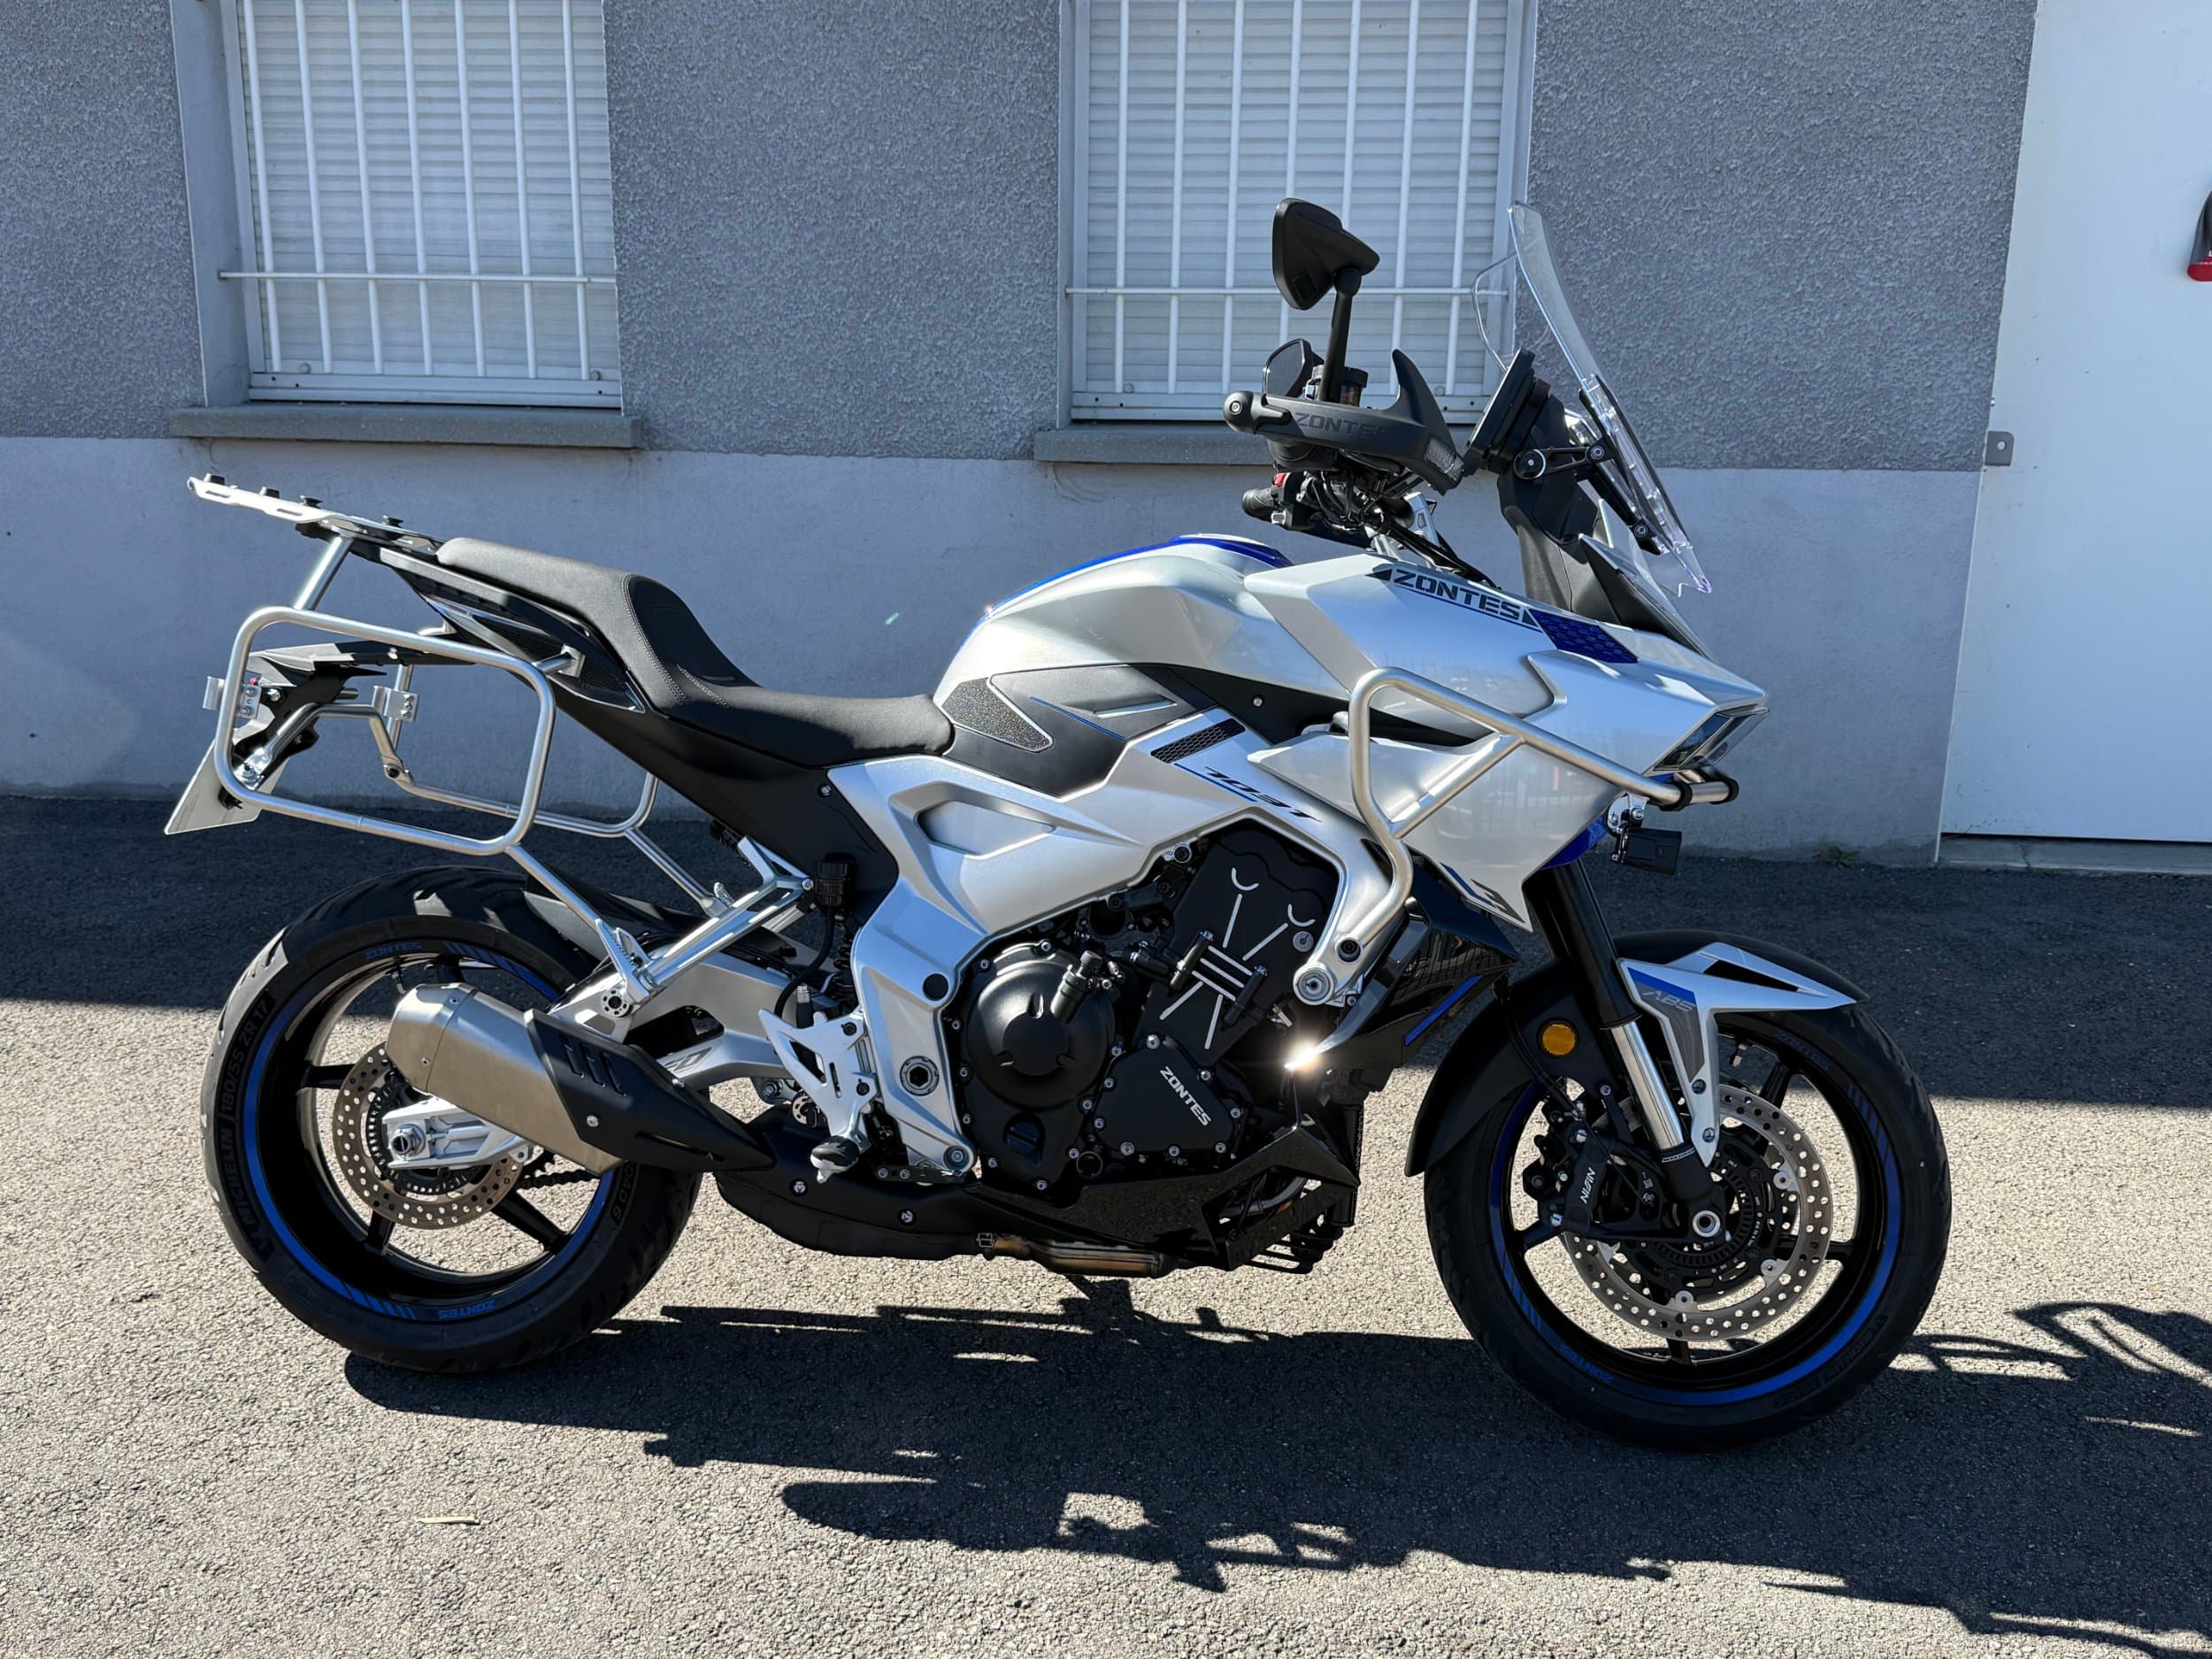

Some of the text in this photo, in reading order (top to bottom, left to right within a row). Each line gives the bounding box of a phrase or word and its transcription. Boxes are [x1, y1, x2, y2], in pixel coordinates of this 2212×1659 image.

[1394, 569, 1520, 620] ZONTES
[365, 941, 423, 961] ZONTES
[1642, 991, 1696, 1012] ABS
[239, 1021, 257, 1045] ZR
[1776, 1033, 1832, 1071] ZONTES
[221, 1049, 246, 1116] 180/55
[1159, 1065, 1211, 1126] ZONTES
[220, 1126, 256, 1226] MICHELIN
[620, 1162, 636, 1202] OAD
[439, 1300, 496, 1318] ZONTES
[1557, 1344, 1614, 1382] ZONTES
